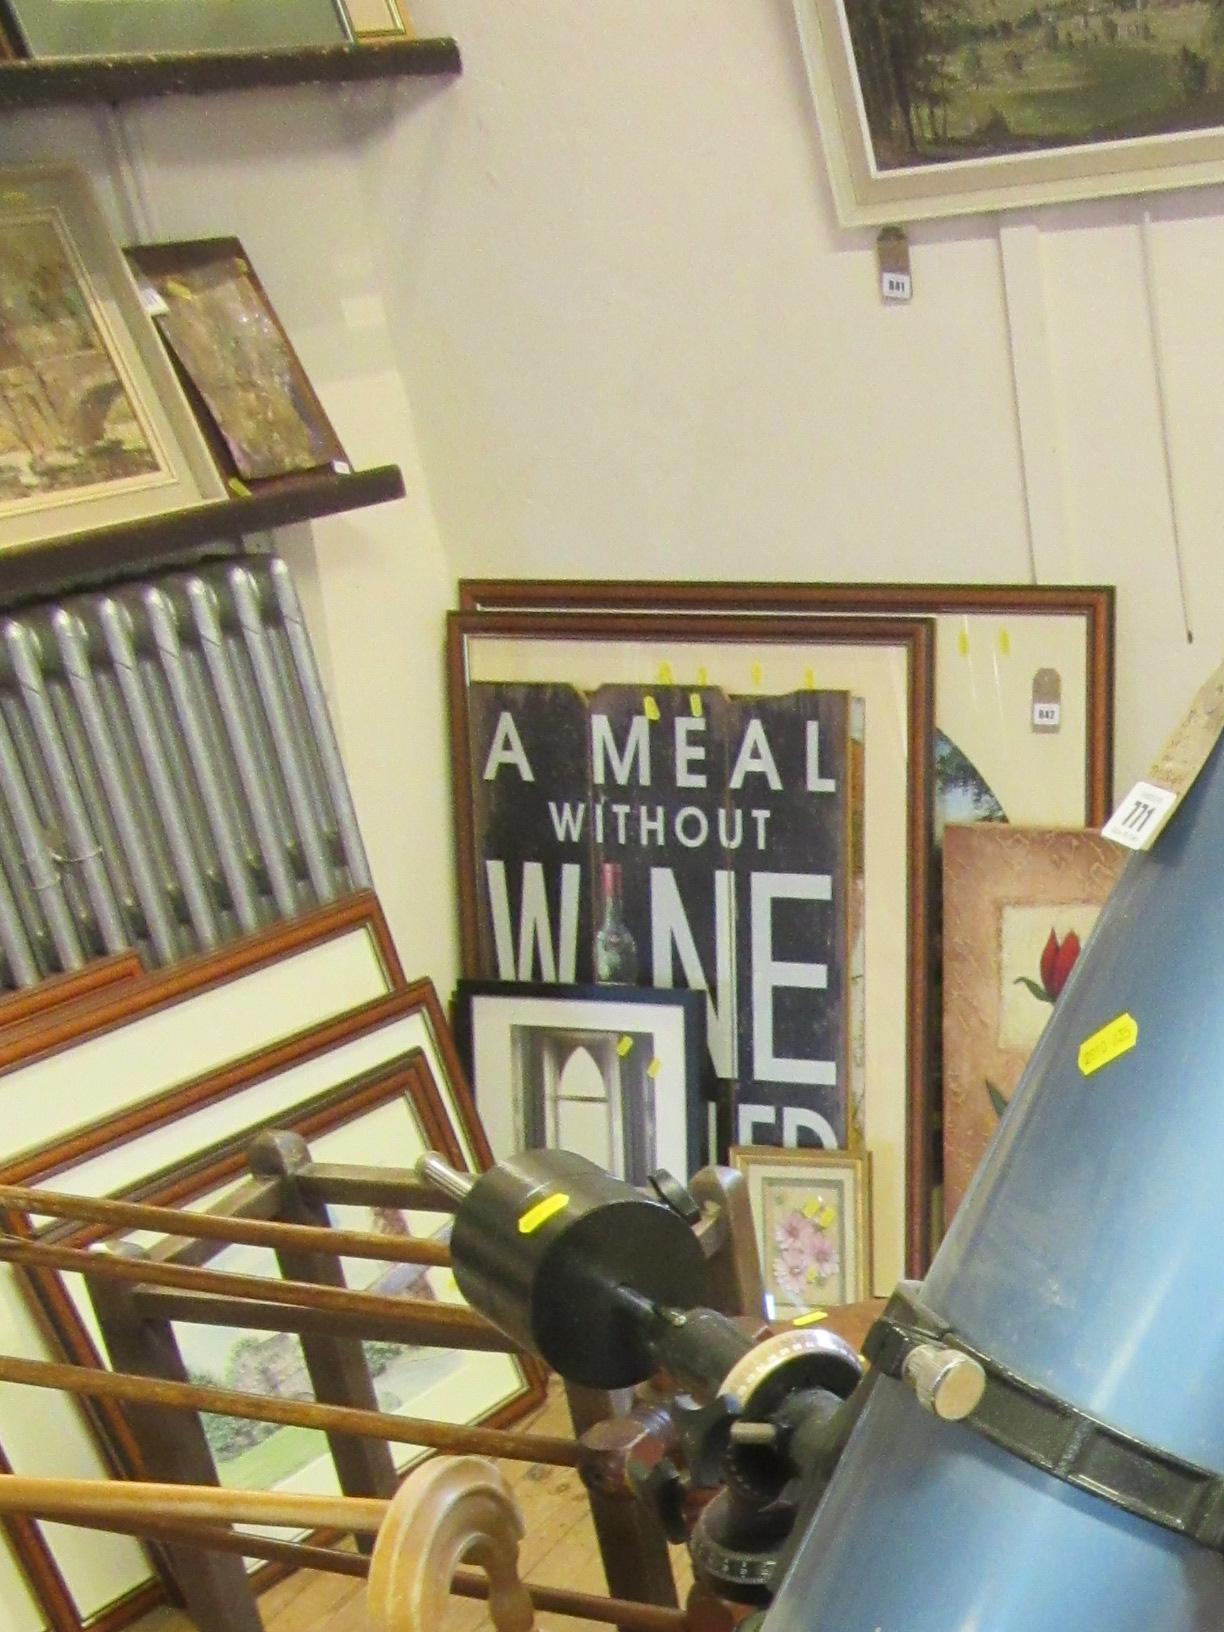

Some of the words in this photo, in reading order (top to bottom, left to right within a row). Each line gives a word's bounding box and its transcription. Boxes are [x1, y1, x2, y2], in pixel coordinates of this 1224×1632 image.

[483, 711, 535, 782] A
[590, 714, 836, 793] MEAL
[548, 801, 771, 850] WITHOUT
[1120, 800, 1156, 832] 771
